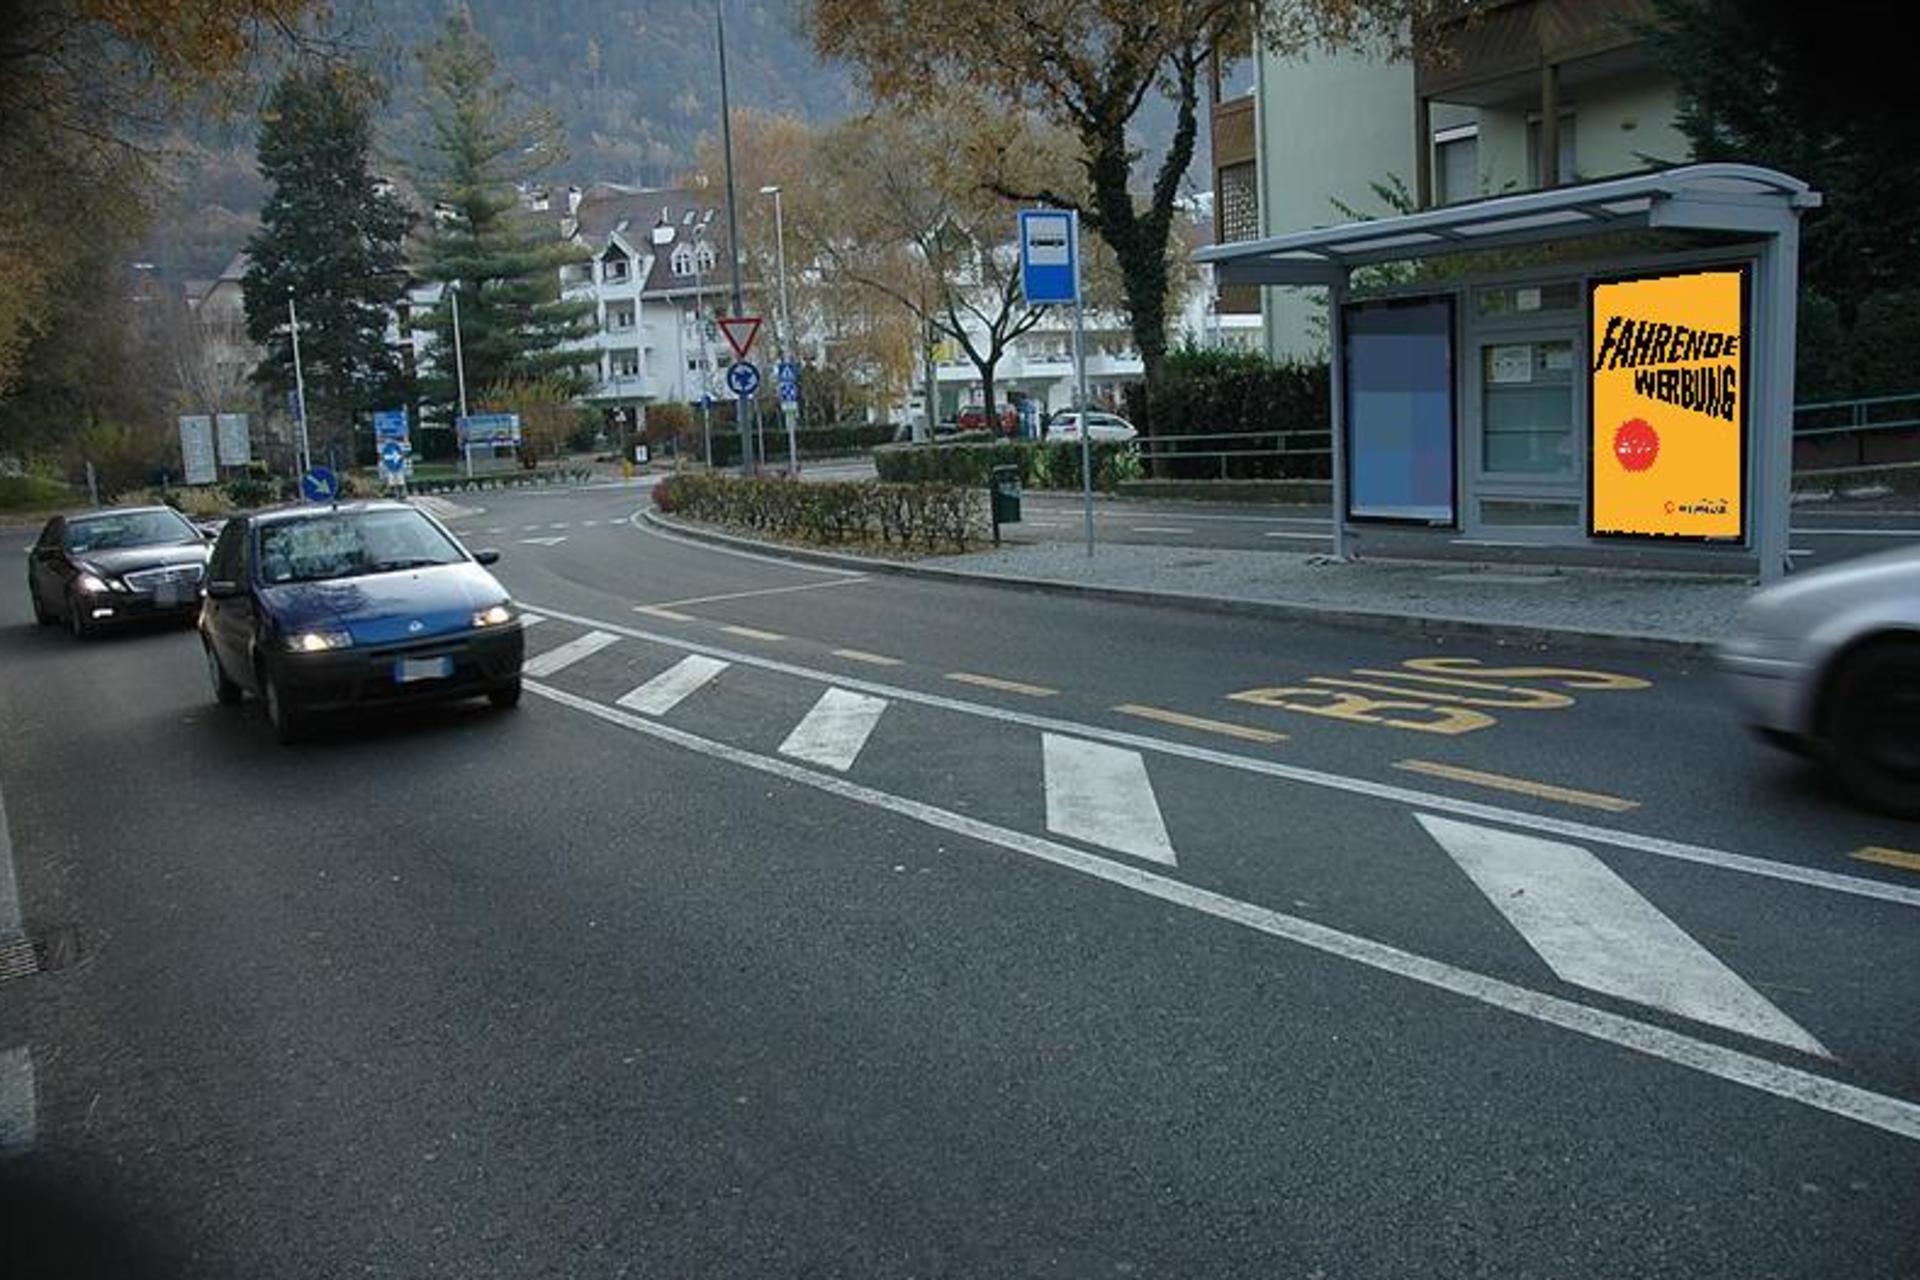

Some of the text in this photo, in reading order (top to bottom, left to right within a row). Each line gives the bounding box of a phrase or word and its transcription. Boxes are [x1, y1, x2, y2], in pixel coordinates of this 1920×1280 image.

[1594, 316, 1741, 372] FAHRENDE
[1635, 365, 1736, 421] WERBUNG
[1225, 658, 1653, 734] BUS
